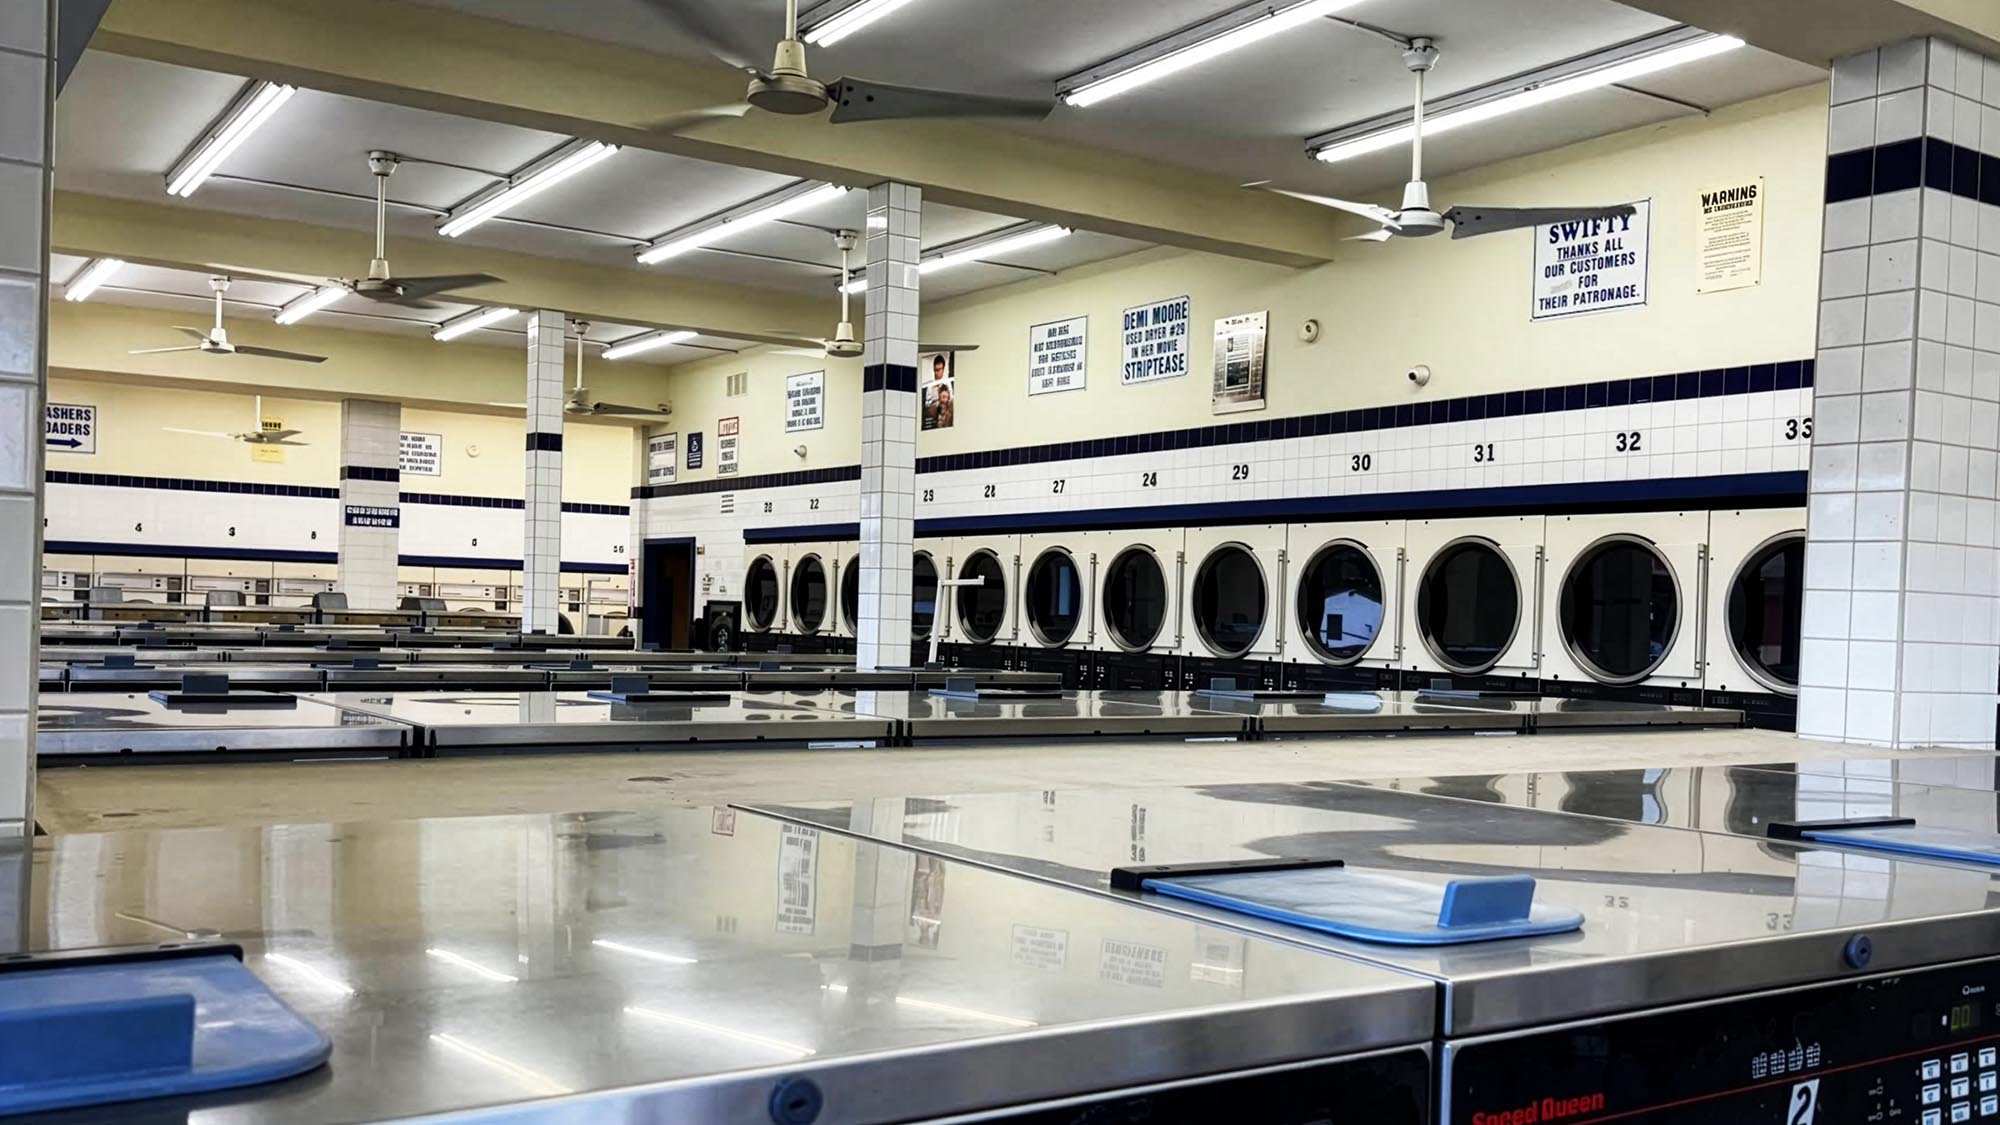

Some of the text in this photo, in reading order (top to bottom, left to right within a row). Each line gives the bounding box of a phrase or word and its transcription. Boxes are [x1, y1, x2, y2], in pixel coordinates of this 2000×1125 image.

[1701, 184, 1757, 207] WARNING
[1549, 213, 1631, 244] SWIFTY
[1557, 237, 1623, 260] THANKS ALL
[1544, 252, 1635, 278] OUR CUSTOMERS
[1578, 274, 1598, 288] FOR
[1539, 284, 1639, 310] THEIR PATRONAGE.
[1124, 301, 1187, 331] DEMI MOORE
[1126, 322, 1185, 345] USED DRYER #29
[1131, 339, 1177, 358] IN HER MOVIE
[1124, 353, 1184, 380] STRIPTEASE
[1785, 418, 1812, 440] 33
[1474, 443, 1495, 462] 31
[1616, 431, 1641, 451] 32
[1232, 464, 1249, 480] 29
[1352, 454, 1371, 471] 30
[1053, 480, 1065, 493] 27
[1541, 1093, 1605, 1121] Queen
[1790, 1085, 1812, 1125] 2
